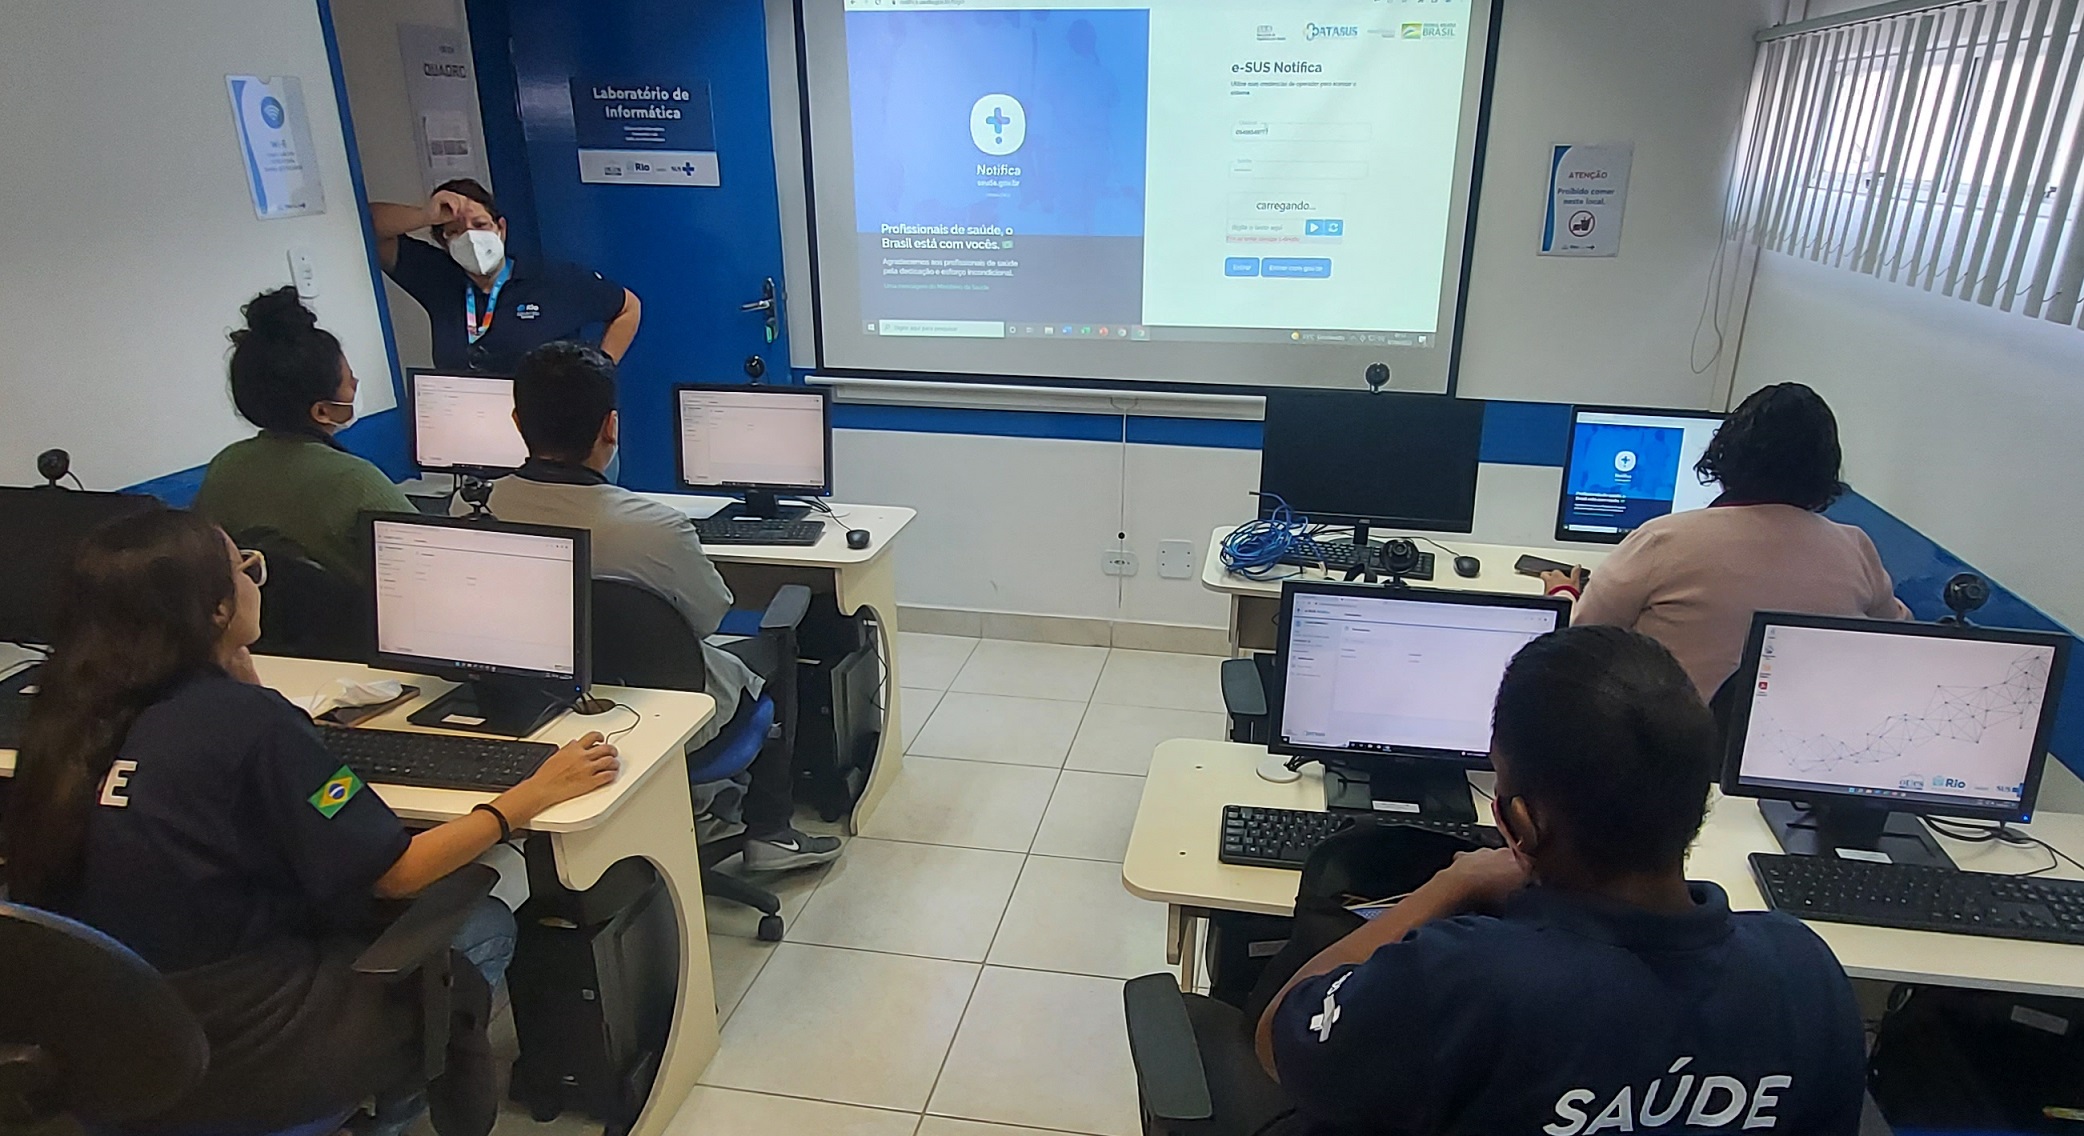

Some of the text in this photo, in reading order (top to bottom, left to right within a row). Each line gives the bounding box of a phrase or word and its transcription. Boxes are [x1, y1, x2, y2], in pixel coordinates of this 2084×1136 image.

[1422, 27, 1456, 37] BRASIL
[1231, 61, 1323, 74] e-SUS Notifica
[592, 86, 690, 101] Laboratório de
[605, 105, 682, 119] Informática
[976, 164, 1022, 176] Notifica
[1568, 170, 1608, 180] ATENÇÃO
[881, 223, 1014, 236] Profissionais de saúde, o
[881, 238, 1001, 250] Brasil está com vocês.
[97, 760, 138, 807] E
[1945, 778, 1966, 788] Rio
[1542, 1056, 1793, 1136] SAÚDE
